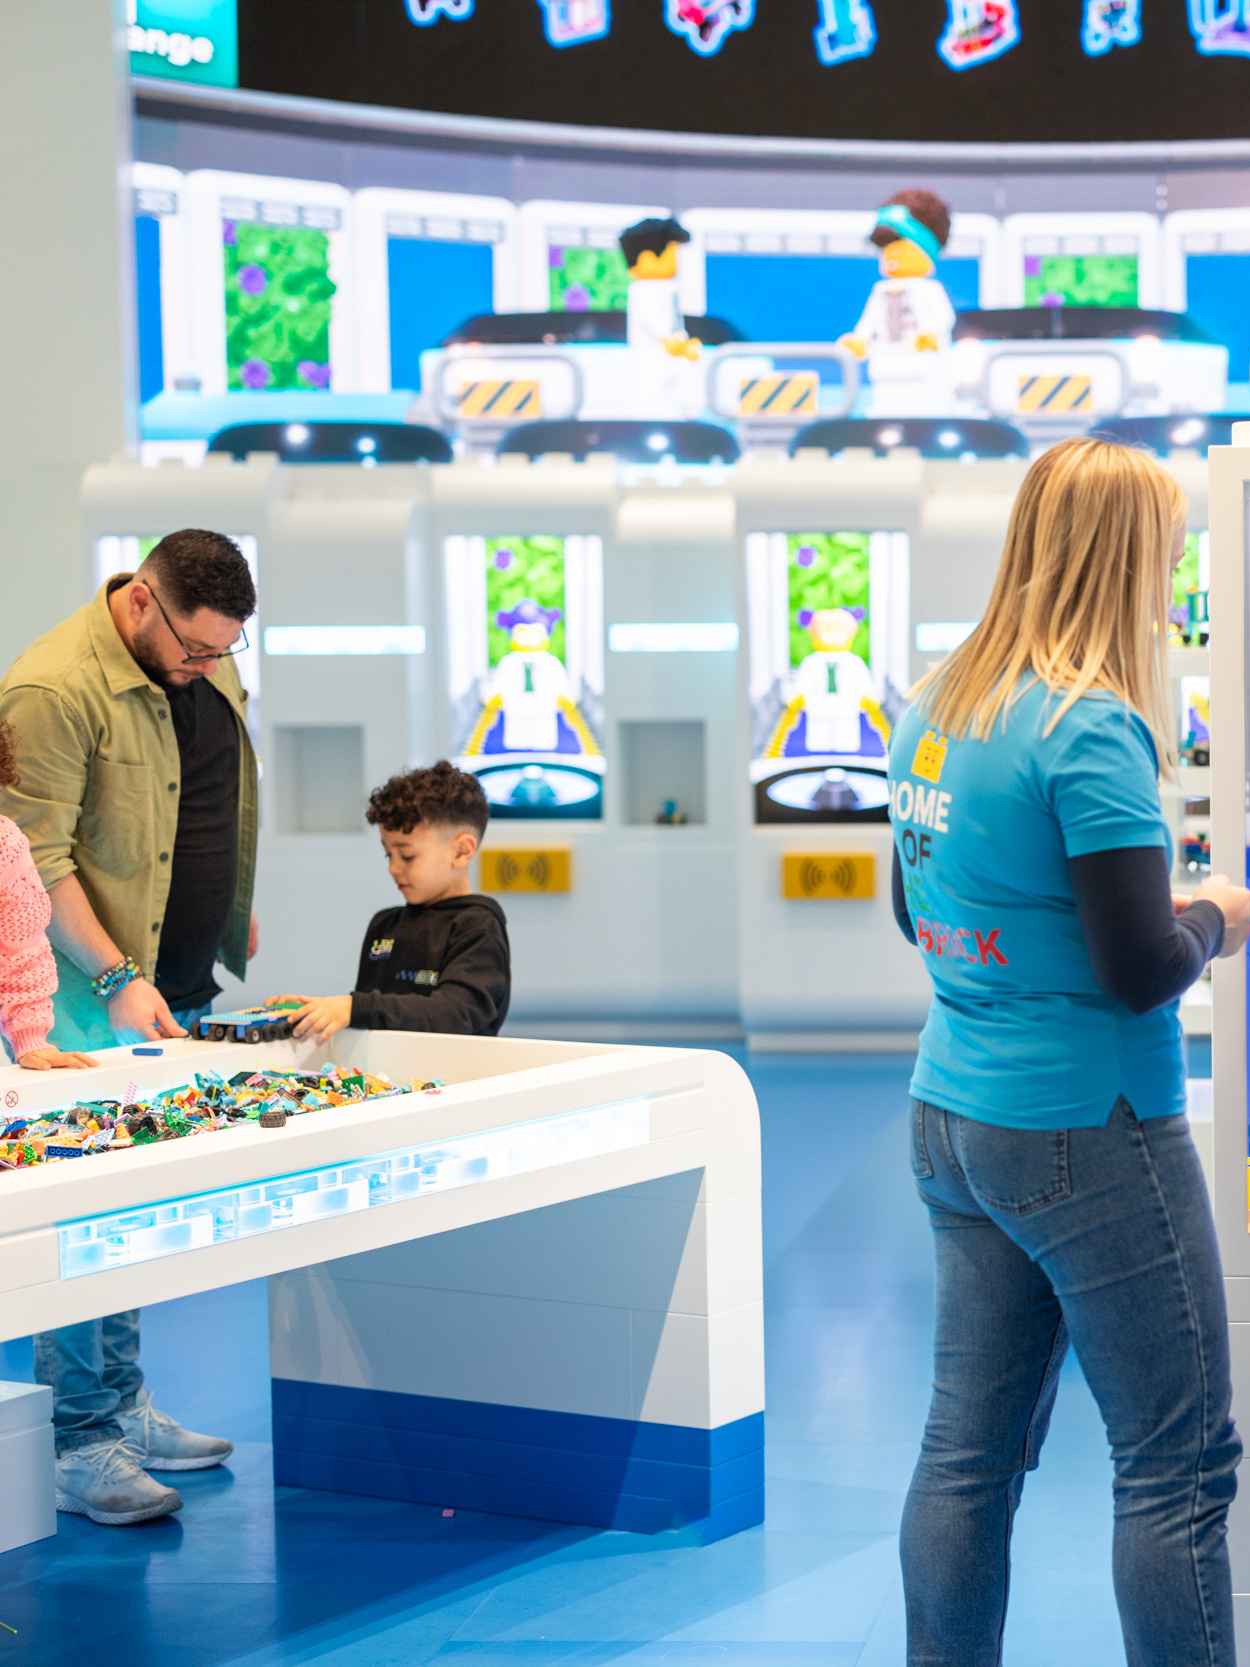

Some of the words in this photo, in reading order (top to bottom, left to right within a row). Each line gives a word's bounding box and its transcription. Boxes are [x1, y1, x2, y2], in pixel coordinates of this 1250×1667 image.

[902, 829, 932, 869] OF
[901, 870, 932, 912] HE
[916, 916, 1009, 966] BRICK
